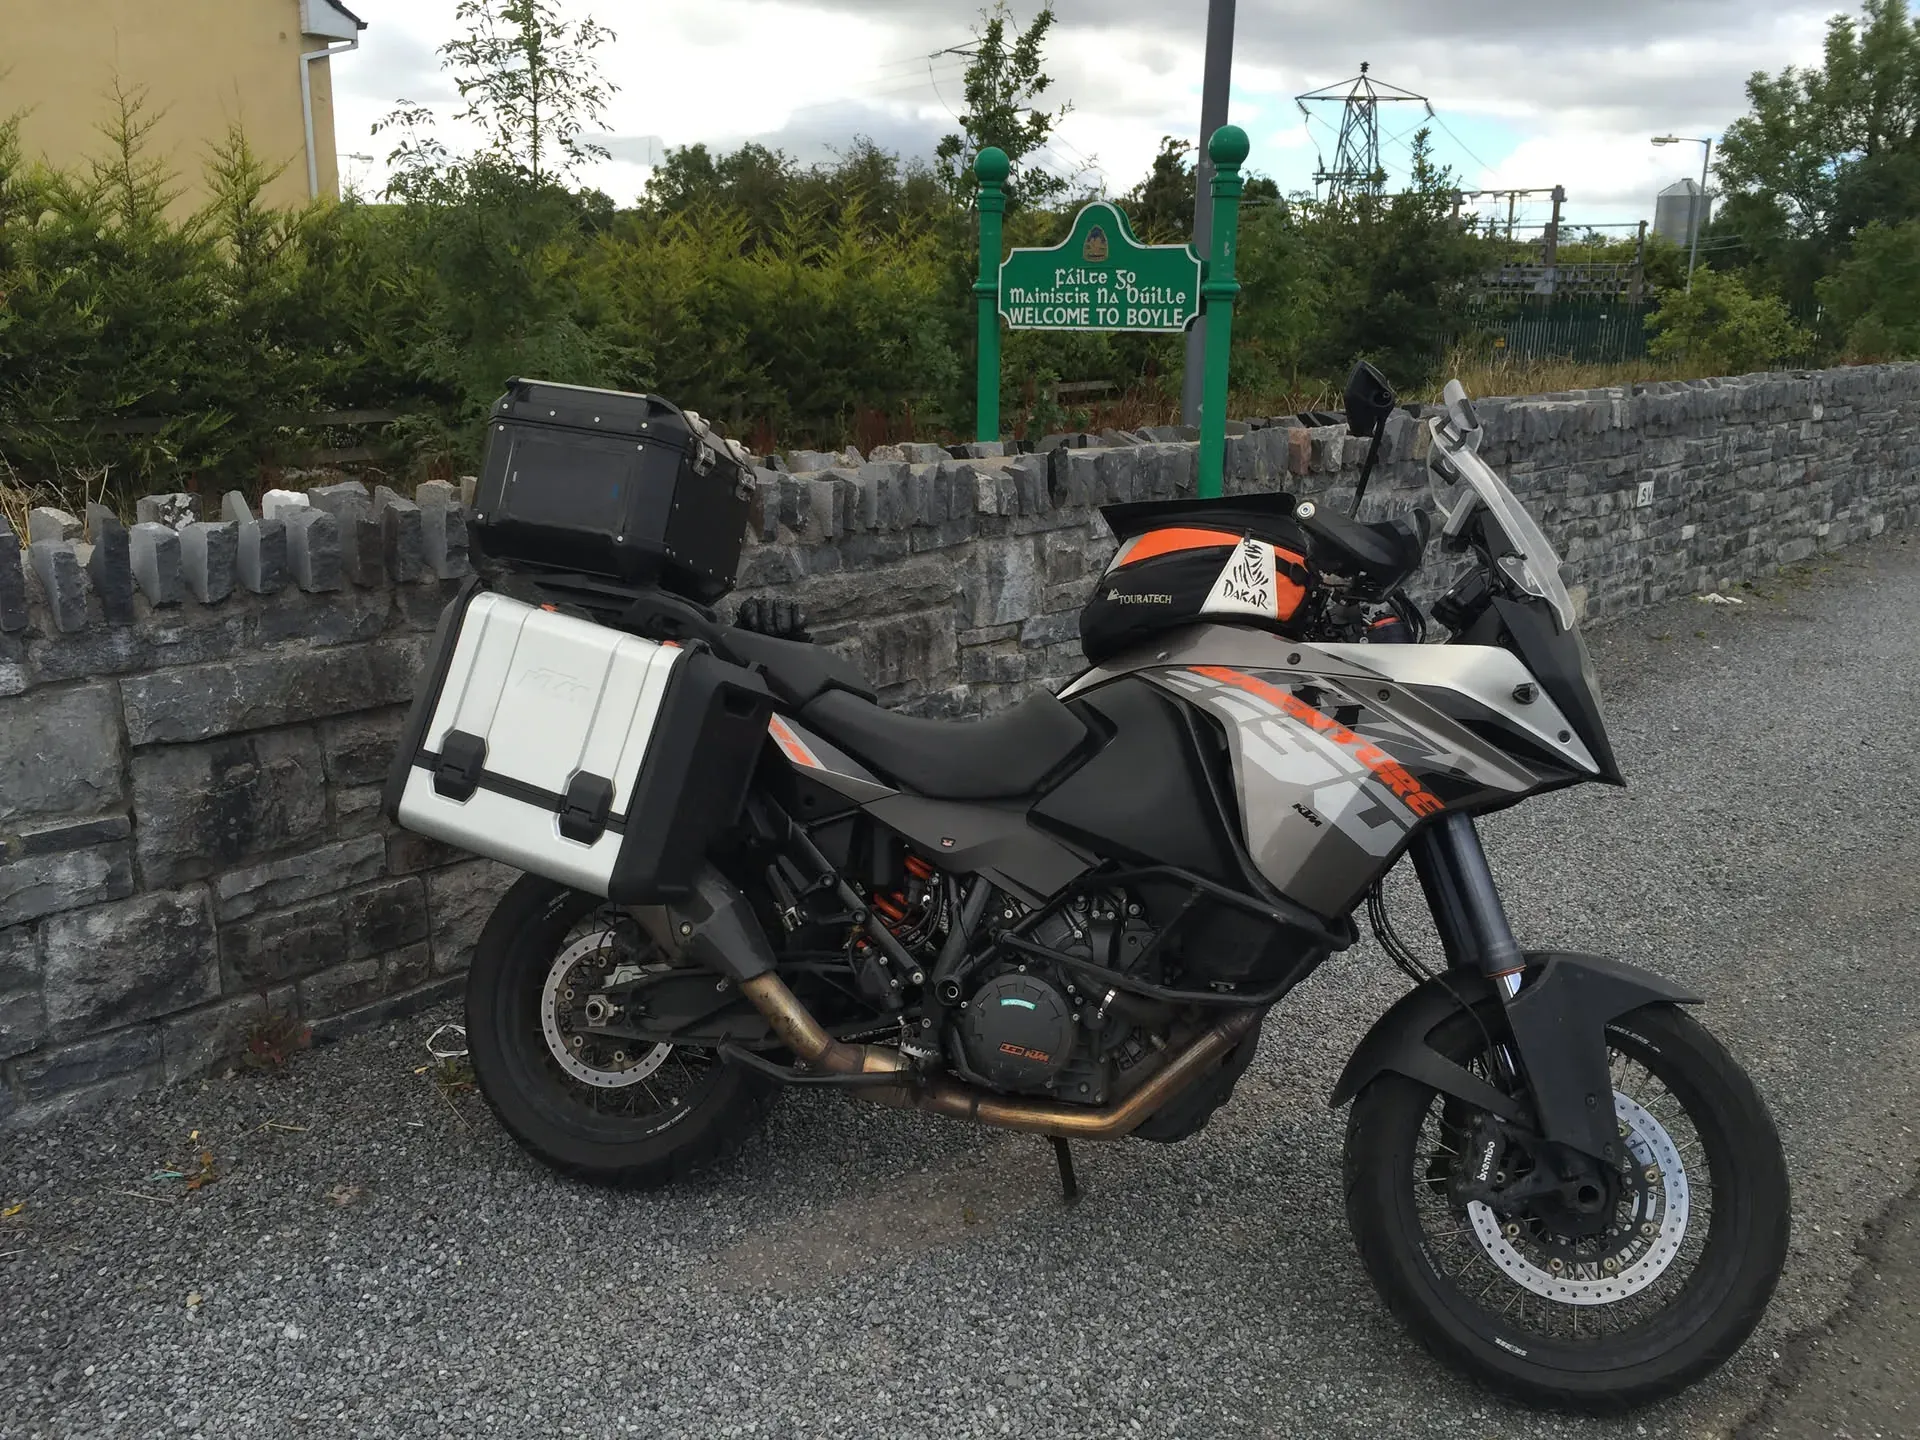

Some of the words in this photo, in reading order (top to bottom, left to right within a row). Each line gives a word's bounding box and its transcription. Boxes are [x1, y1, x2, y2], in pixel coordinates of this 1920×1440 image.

[1009, 306, 1090, 325] WELCOME
[1096, 307, 1120, 325] TO
[1126, 308, 1184, 327] BOYLE
[1119, 592, 1172, 605] TOURATECH
[1222, 578, 1268, 610] DAKAR
[1291, 802, 1324, 828] KTM
[1476, 1141, 1496, 1181] brembo
